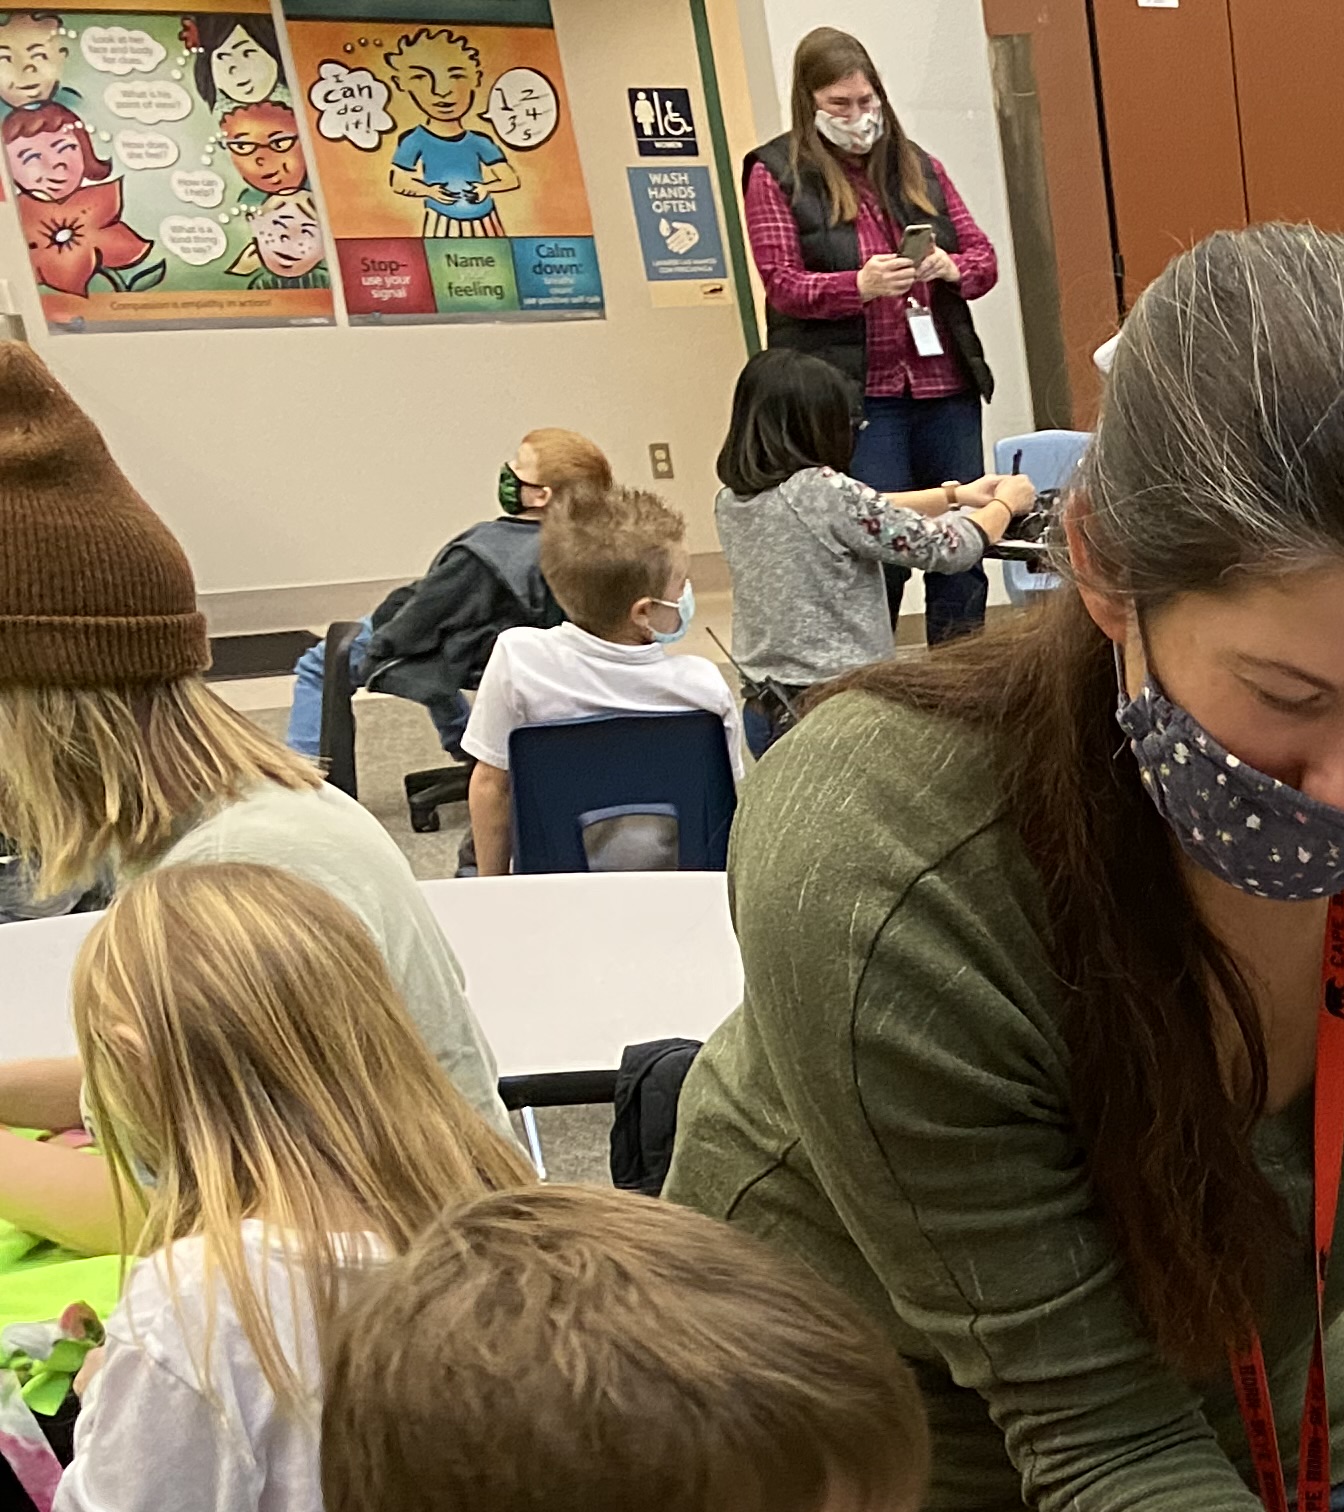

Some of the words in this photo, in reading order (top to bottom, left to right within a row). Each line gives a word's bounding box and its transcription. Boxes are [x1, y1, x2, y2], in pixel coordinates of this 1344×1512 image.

[323, 84, 374, 103] can
[495, 88, 513, 111] 1
[520, 89, 539, 101] 2
[337, 104, 363, 115] do
[345, 112, 371, 133] it!
[505, 115, 517, 134] 3
[525, 107, 540, 120] 4
[649, 172, 688, 185] WASH
[647, 186, 696, 200] HANDS
[652, 200, 697, 213] OFTEN
[536, 244, 575, 258] Calm
[445, 254, 495, 268] Name
[533, 260, 583, 275] down:
[362, 276, 383, 285] use
[386, 275, 412, 287] your
[371, 287, 408, 301] signal
[448, 283, 504, 300] feeling
